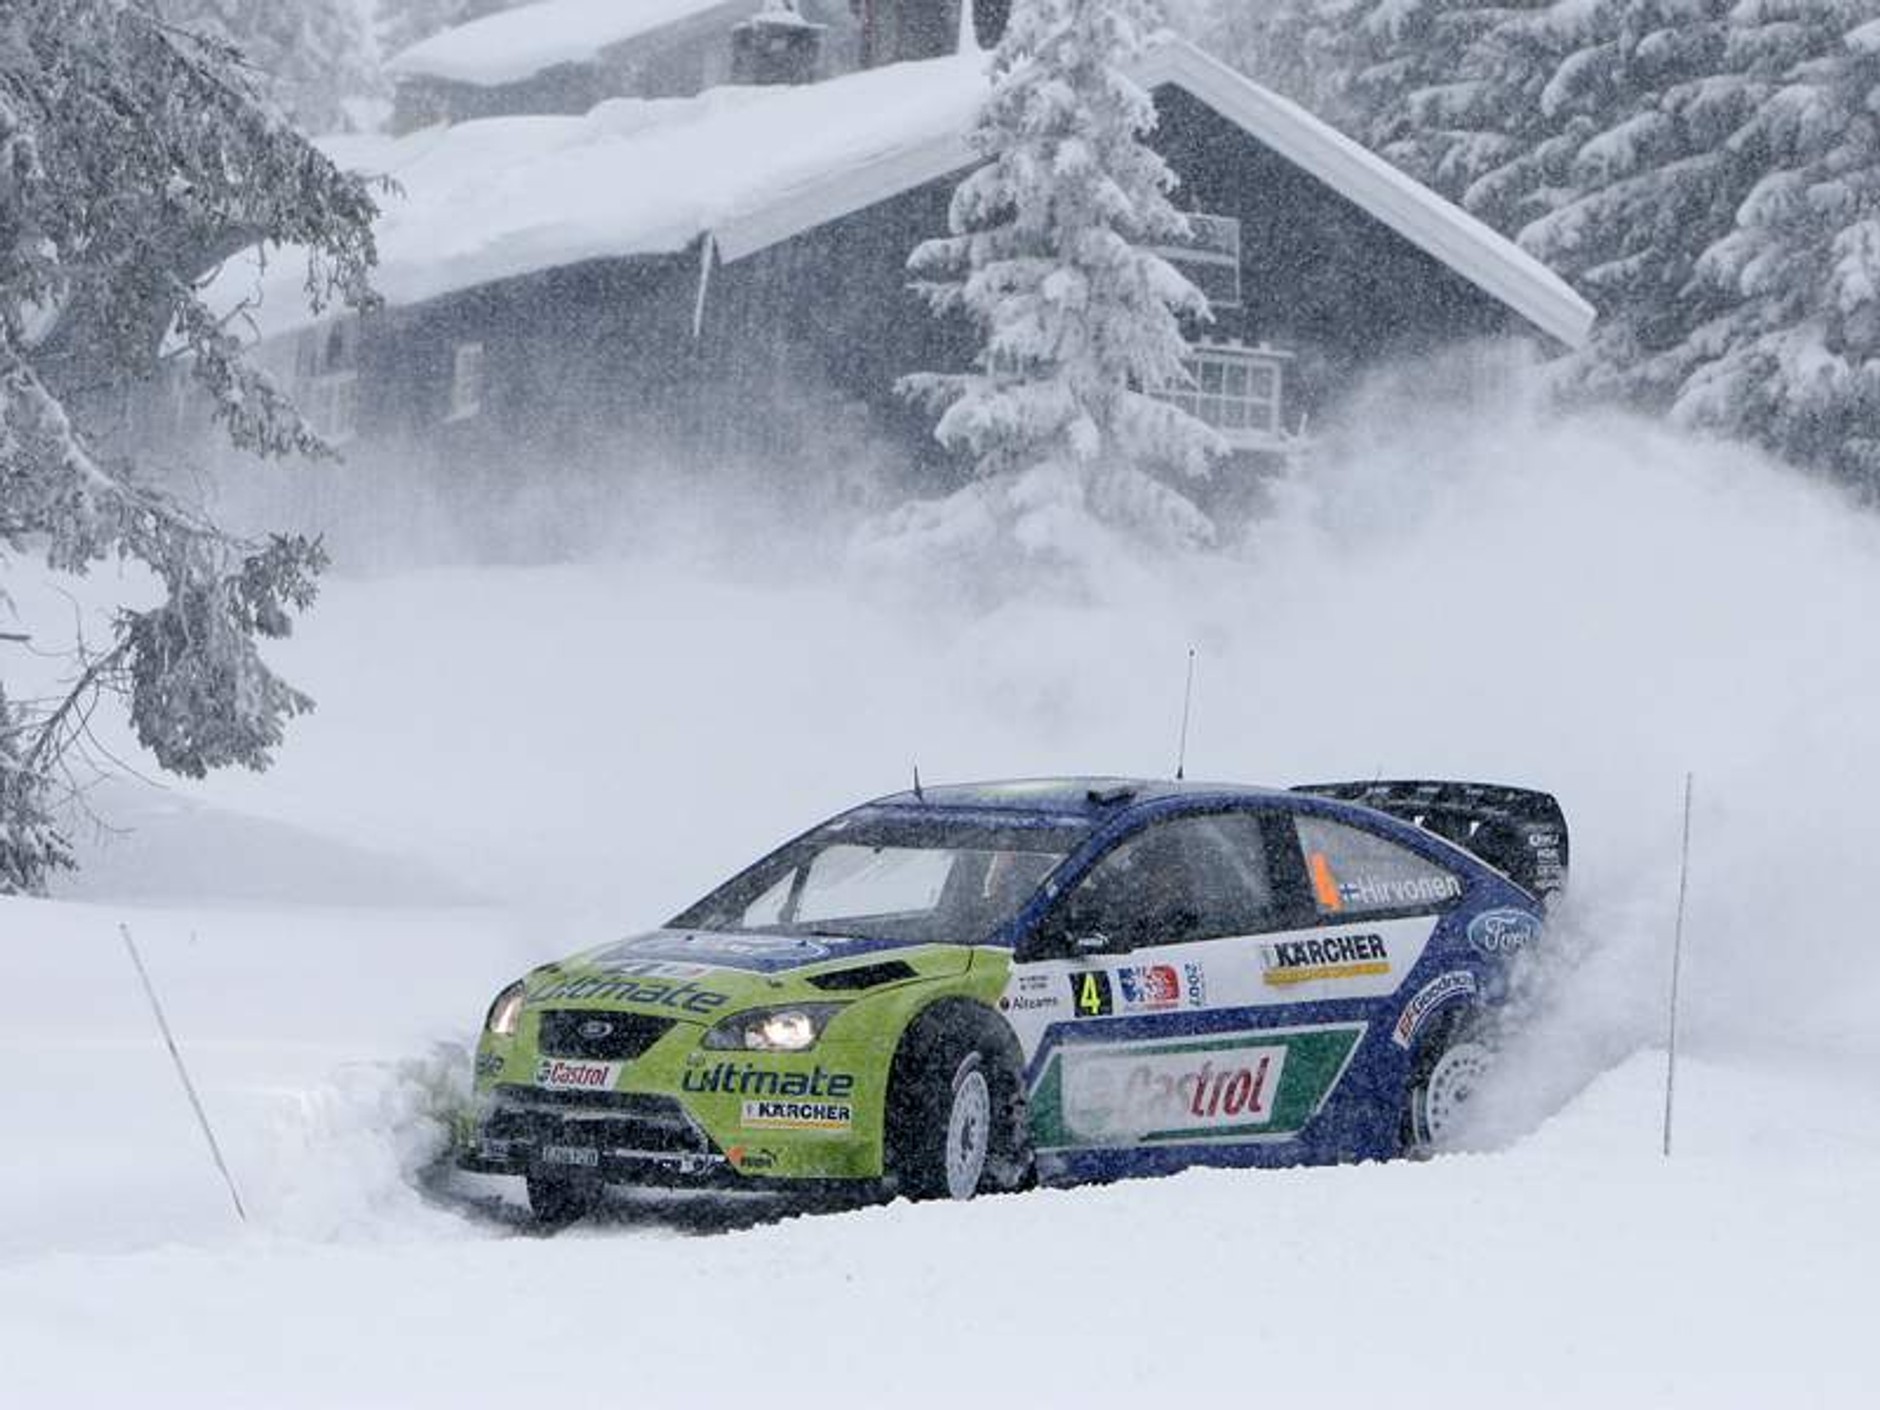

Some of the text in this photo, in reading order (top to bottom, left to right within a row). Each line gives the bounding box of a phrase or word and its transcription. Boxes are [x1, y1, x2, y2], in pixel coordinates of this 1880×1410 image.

[1358, 874, 1461, 904] Hirvonen
[1273, 933, 1387, 967] KÄRCHER
[1081, 973, 1100, 1015] 4
[551, 1062, 610, 1086] Castrol
[682, 1063, 854, 1098] ultimate
[758, 1102, 850, 1121] KÄRCHER
